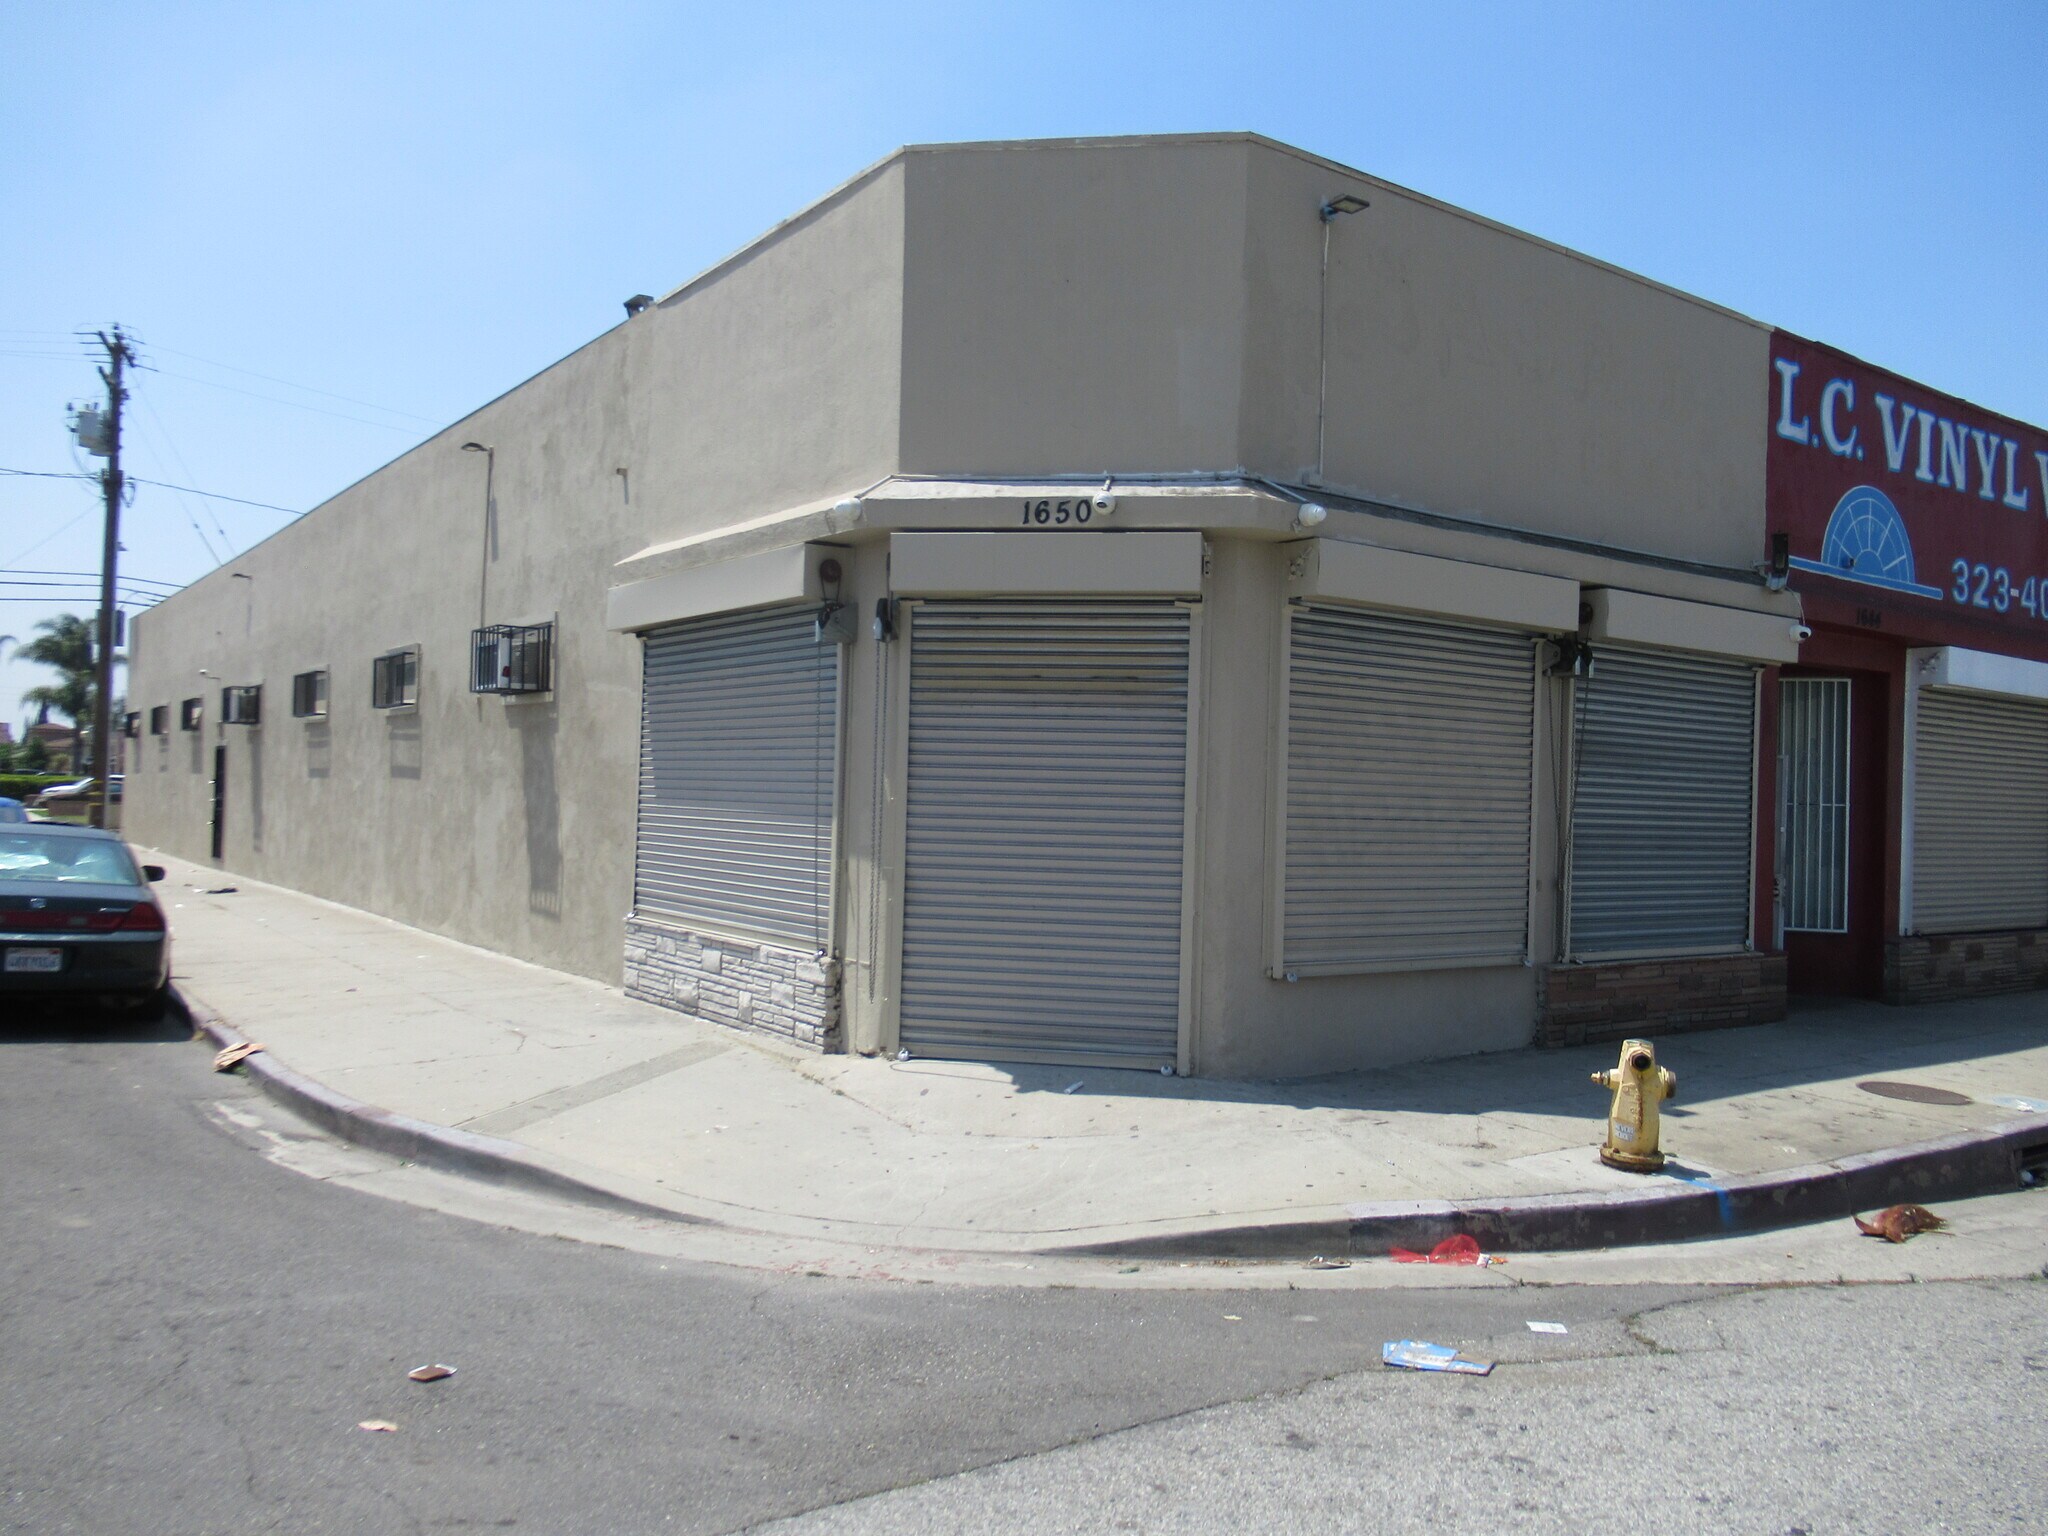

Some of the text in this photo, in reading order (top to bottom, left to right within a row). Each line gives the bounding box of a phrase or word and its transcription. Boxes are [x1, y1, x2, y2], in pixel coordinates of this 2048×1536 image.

[1775, 357, 1864, 461] L.C.
[1874, 392, 2028, 511] VINYL
[1022, 499, 1092, 525] 1650
